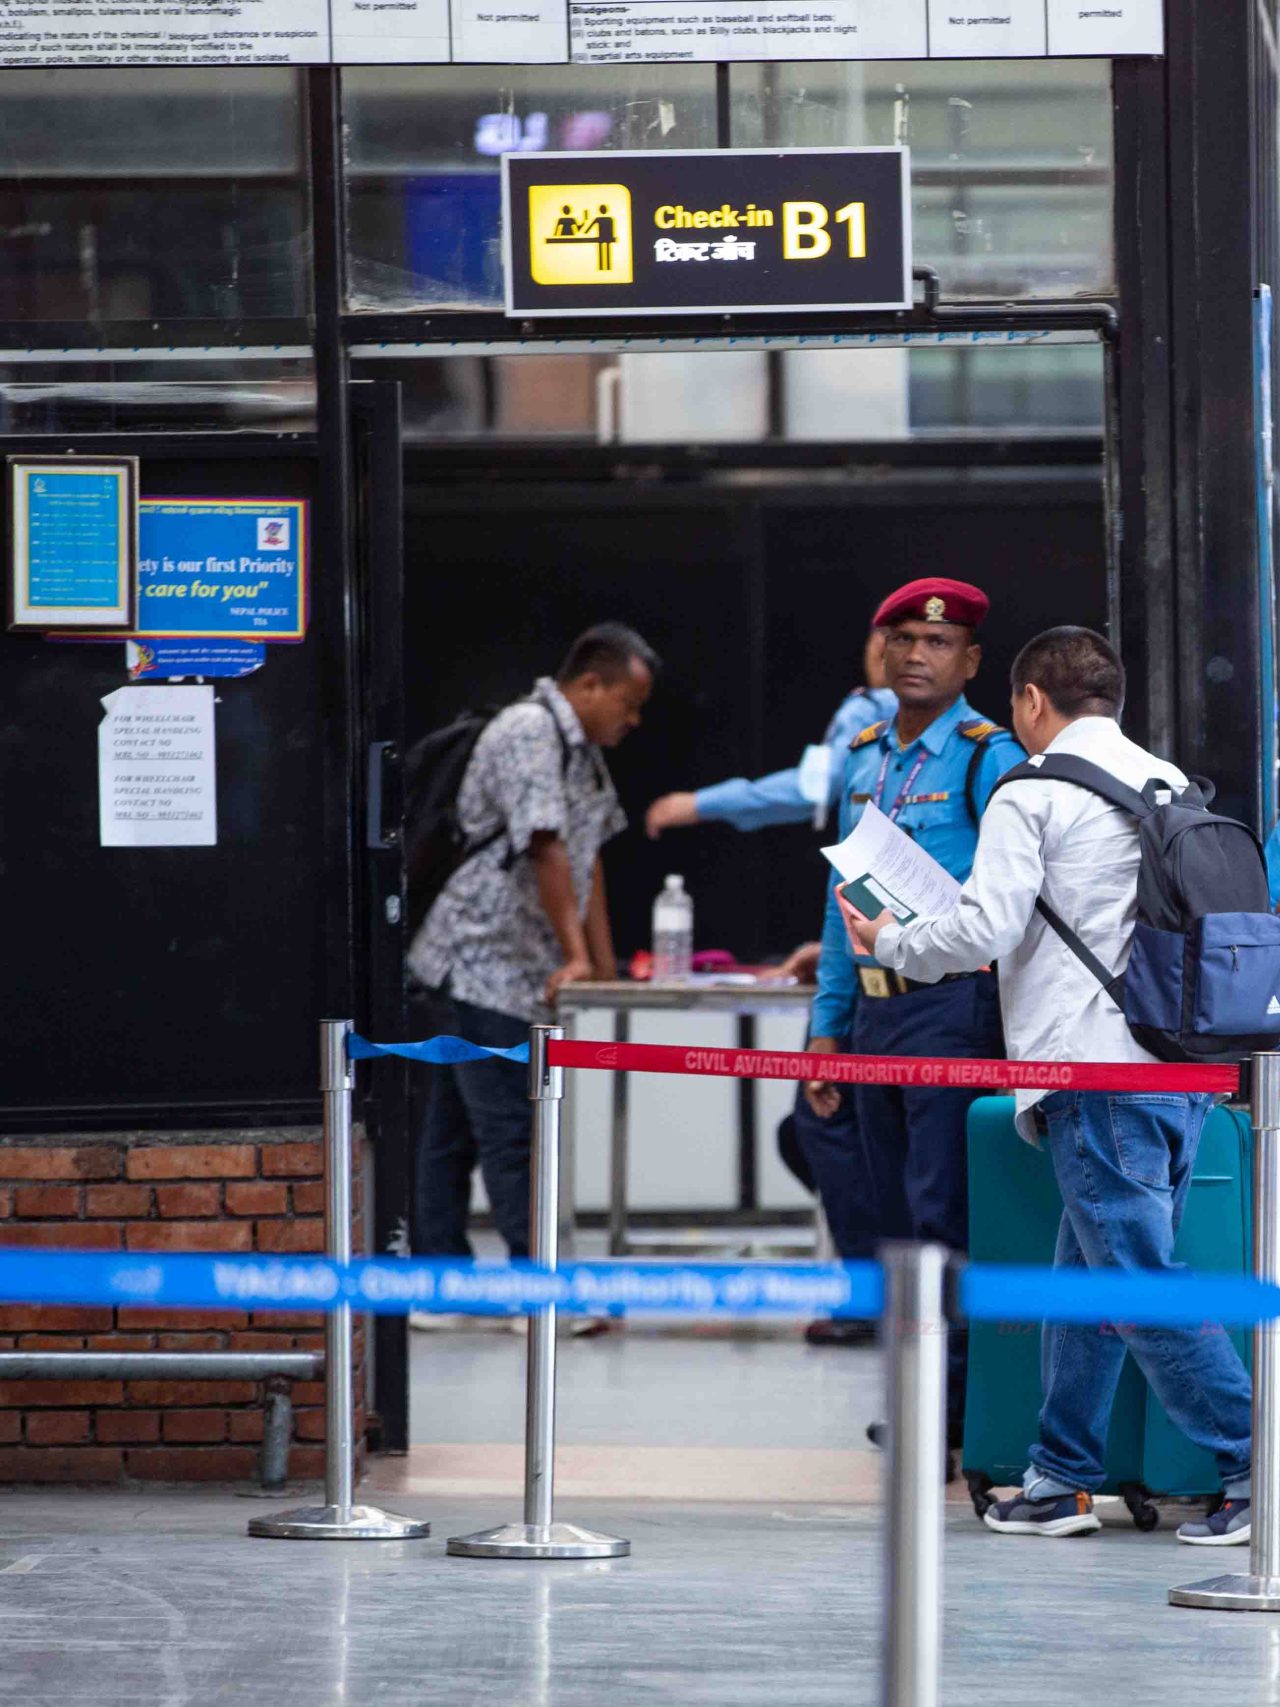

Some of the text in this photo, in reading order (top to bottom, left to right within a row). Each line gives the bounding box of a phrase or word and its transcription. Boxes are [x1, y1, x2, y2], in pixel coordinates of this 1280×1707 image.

[354, 2, 417, 11] Not permitted
[477, 13, 540, 23] Not permitted
[584, 17, 623, 26] Sporting
[626, 16, 675, 26] equipment
[677, 15, 699, 23] such
[715, 14, 754, 23] baseball
[757, 14, 774, 22] and
[776, 13, 810, 22] softball
[1078, 9, 1122, 19] permitted
[948, 16, 1011, 26] Not permitted
[0, 32, 41, 42] ndicating
[44, 31, 58, 39] the
[103, 31, 118, 39] the
[120, 31, 161, 39] chemical
[168, 34, 209, 42] biological
[213, 31, 259, 39] substance
[274, 31, 318, 40] suspicion
[587, 29, 612, 38] clubs
[615, 28, 631, 37] and
[671, 27, 695, 35] such
[710, 26, 729, 36] Billy
[763, 25, 811, 35] blackjacks
[814, 25, 831, 33] and
[833, 25, 858, 35] night
[64, 43, 93, 51] nature
[96, 43, 118, 51] shall
[134, 43, 188, 53] immediately
[191, 42, 225, 50] notified
[238, 42, 254, 50] the
[614, 40, 632, 48] and
[78, 54, 111, 65] military
[126, 55, 151, 63] other
[153, 54, 189, 63] relevant
[191, 54, 231, 65] authority
[234, 53, 251, 62] and
[590, 51, 622, 60] martial
[624, 51, 642, 59] arts
[645, 50, 694, 60] equipment
[654, 204, 774, 229] Check-in
[782, 201, 867, 260] B1
[163, 557, 175, 573] is
[177, 560, 204, 573] our
[206, 557, 236, 573] first
[239, 557, 295, 577] Priority
[145, 583, 187, 598] care
[191, 580, 220, 598] for
[114, 715, 132, 723] FOR
[114, 775, 132, 783] FOR
[684, 1051, 730, 1073] CIVIL
[734, 1053, 811, 1076] AVIATION
[818, 1059, 916, 1083] AUTHORITY
[921, 1064, 944, 1084] OF
